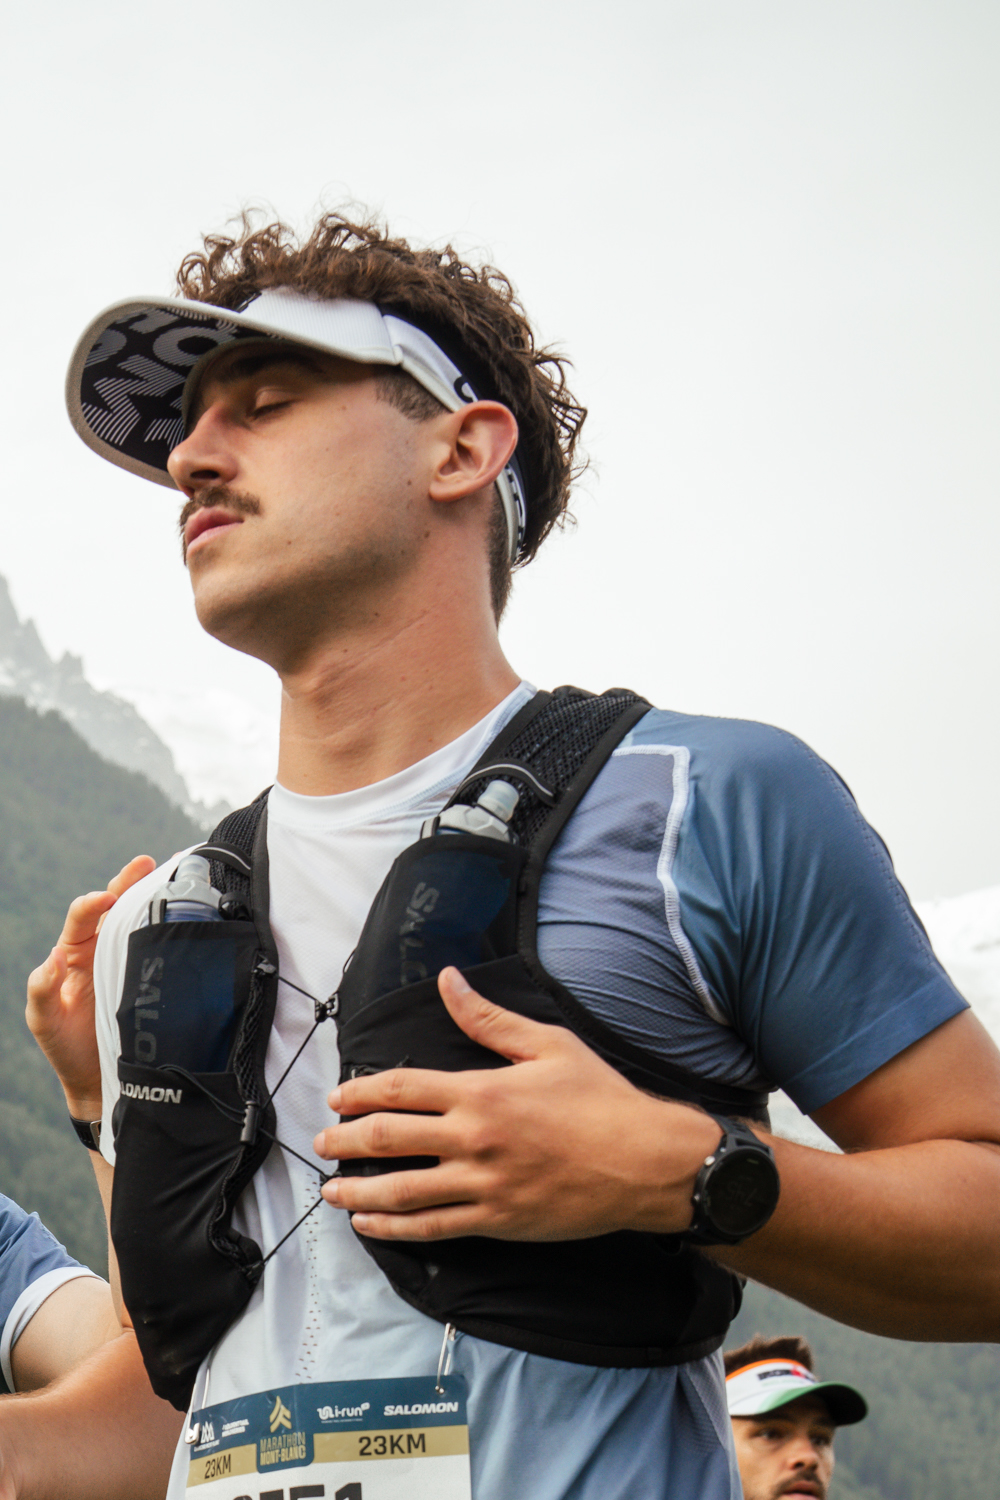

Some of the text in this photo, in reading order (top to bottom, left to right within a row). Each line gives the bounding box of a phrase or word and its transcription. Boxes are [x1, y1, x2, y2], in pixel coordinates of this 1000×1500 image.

[383, 1401, 459, 1416] SALOMON
[260, 1431, 306, 1452] MARATHON
[358, 1433, 426, 1457] 23KM
[260, 1444, 307, 1466] MONT-BLANC
[204, 1453, 232, 1480] 23KM
